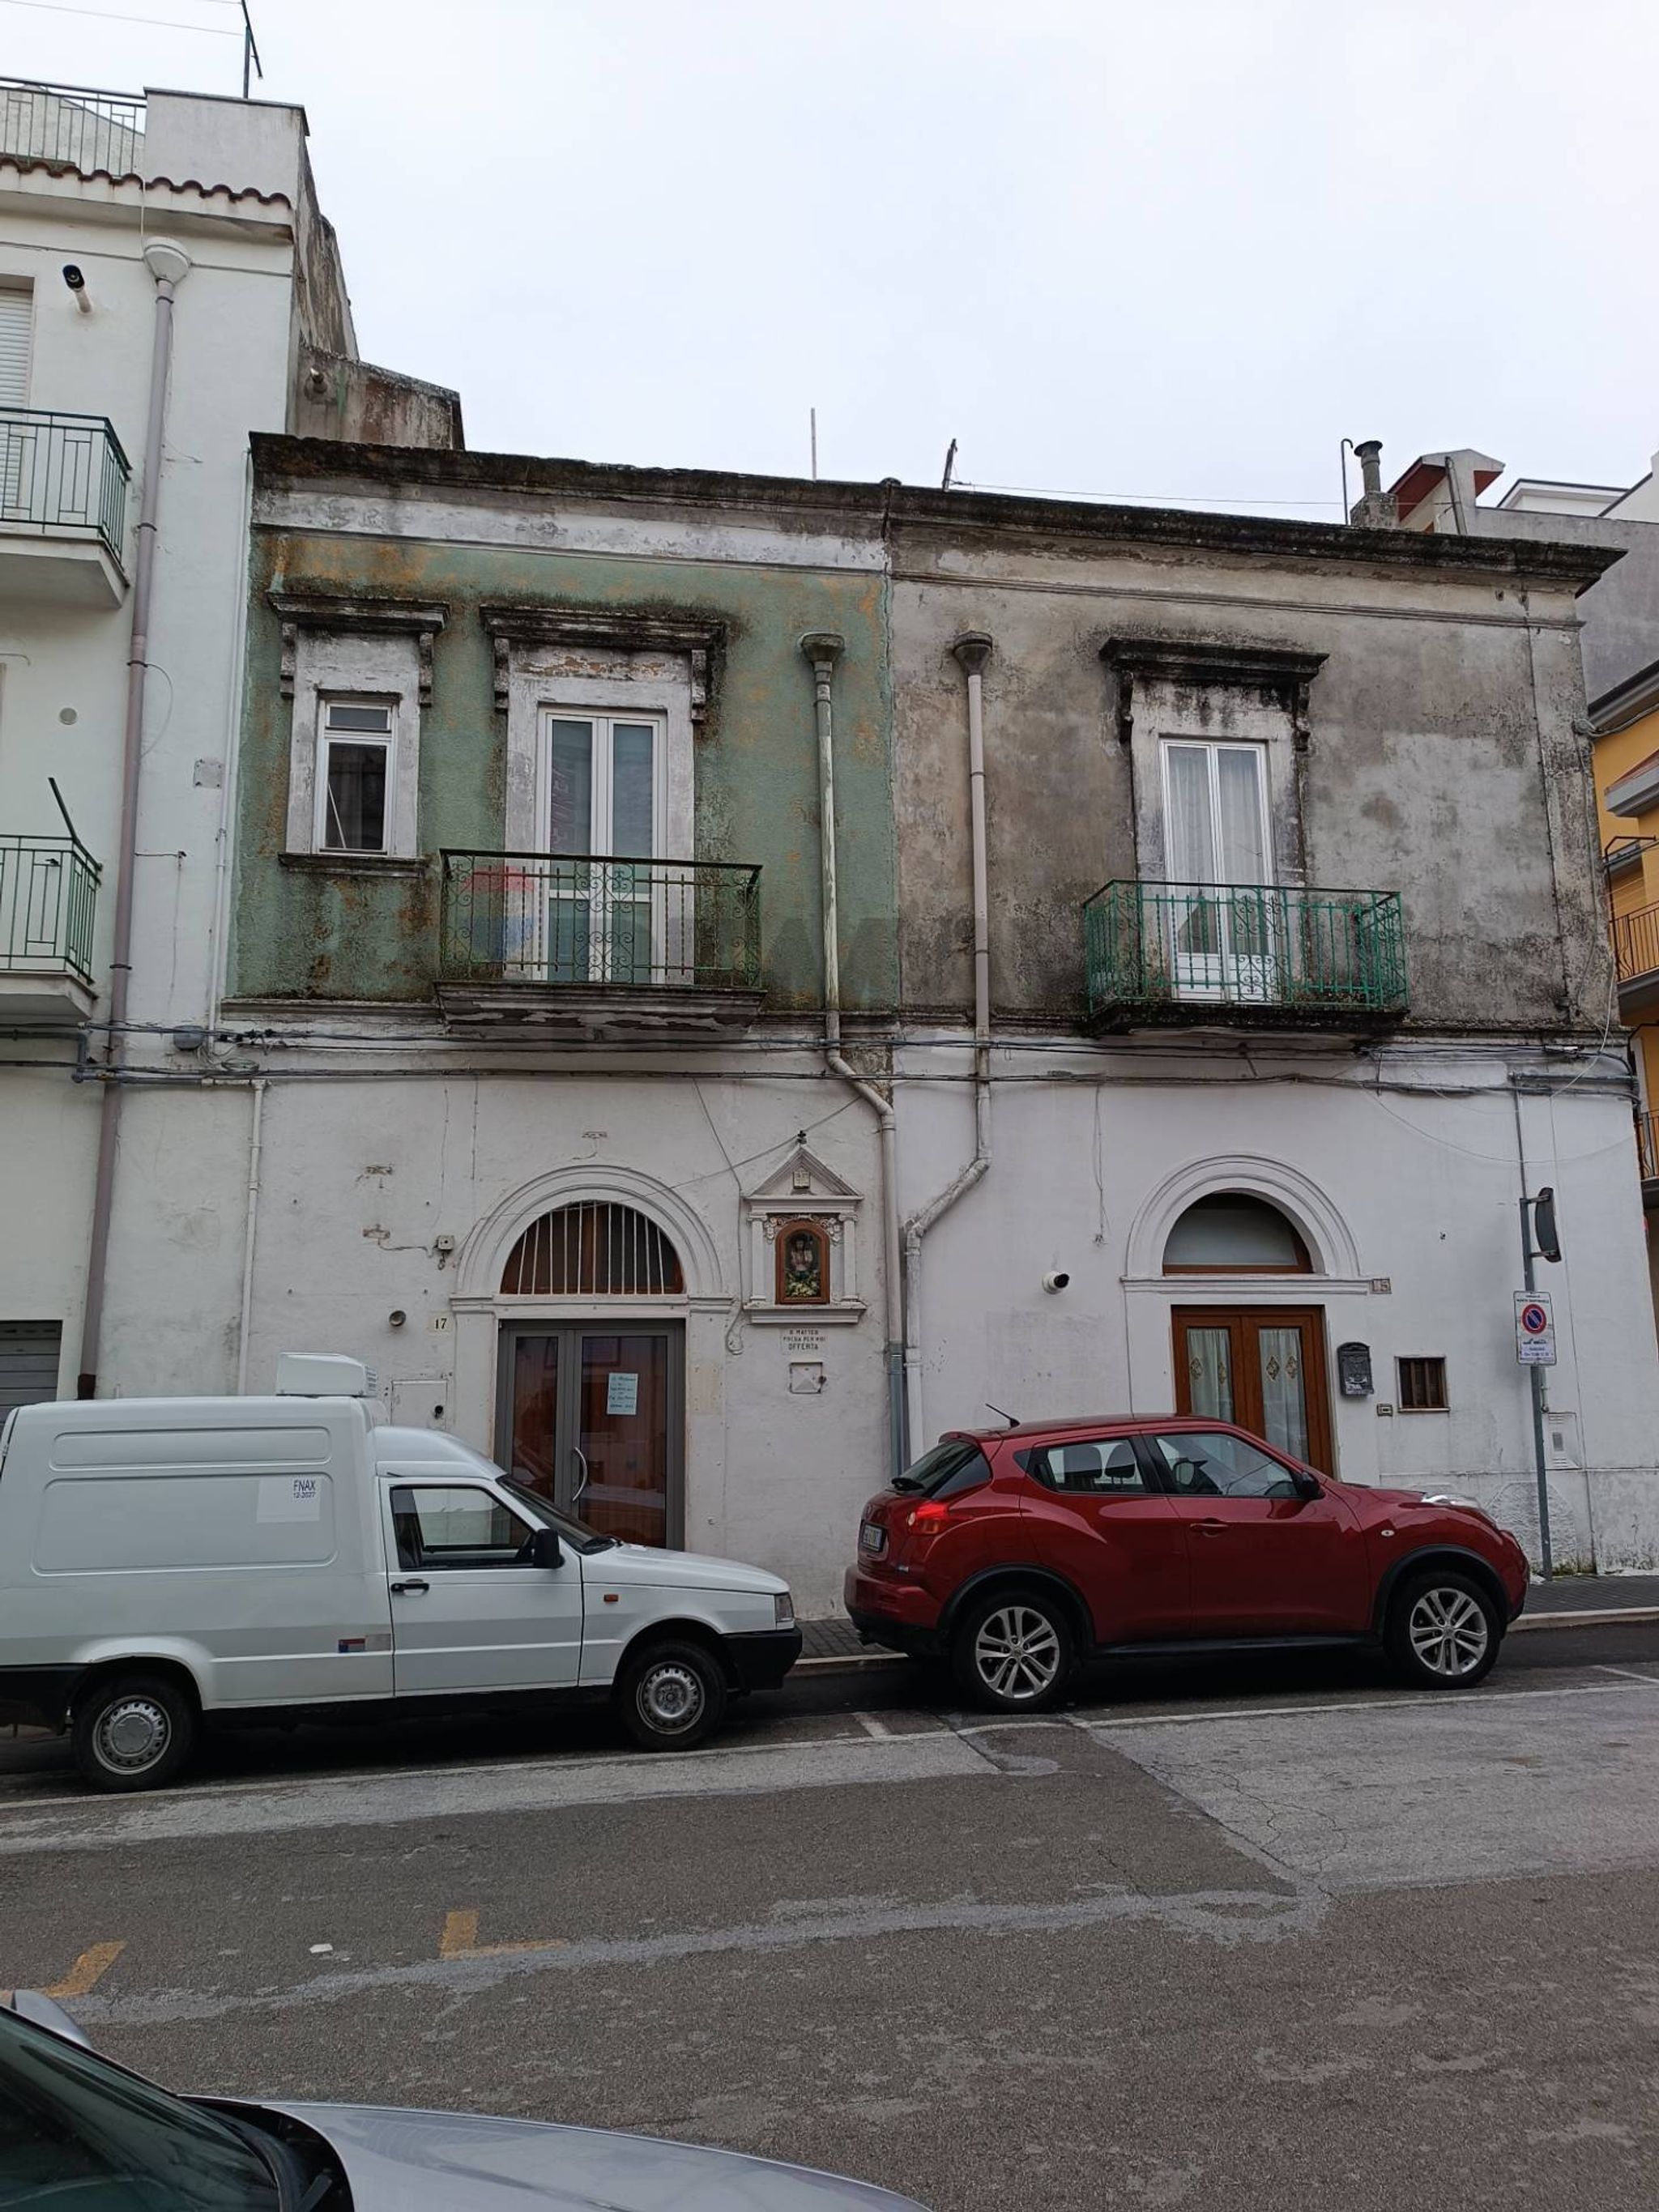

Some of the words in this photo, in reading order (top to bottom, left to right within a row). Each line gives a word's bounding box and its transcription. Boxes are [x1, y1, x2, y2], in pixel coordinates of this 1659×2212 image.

[435, 1318, 447, 1329] 17
[788, 1343, 819, 1351] OFFERTA
[293, 1479, 316, 1492] FNAX
